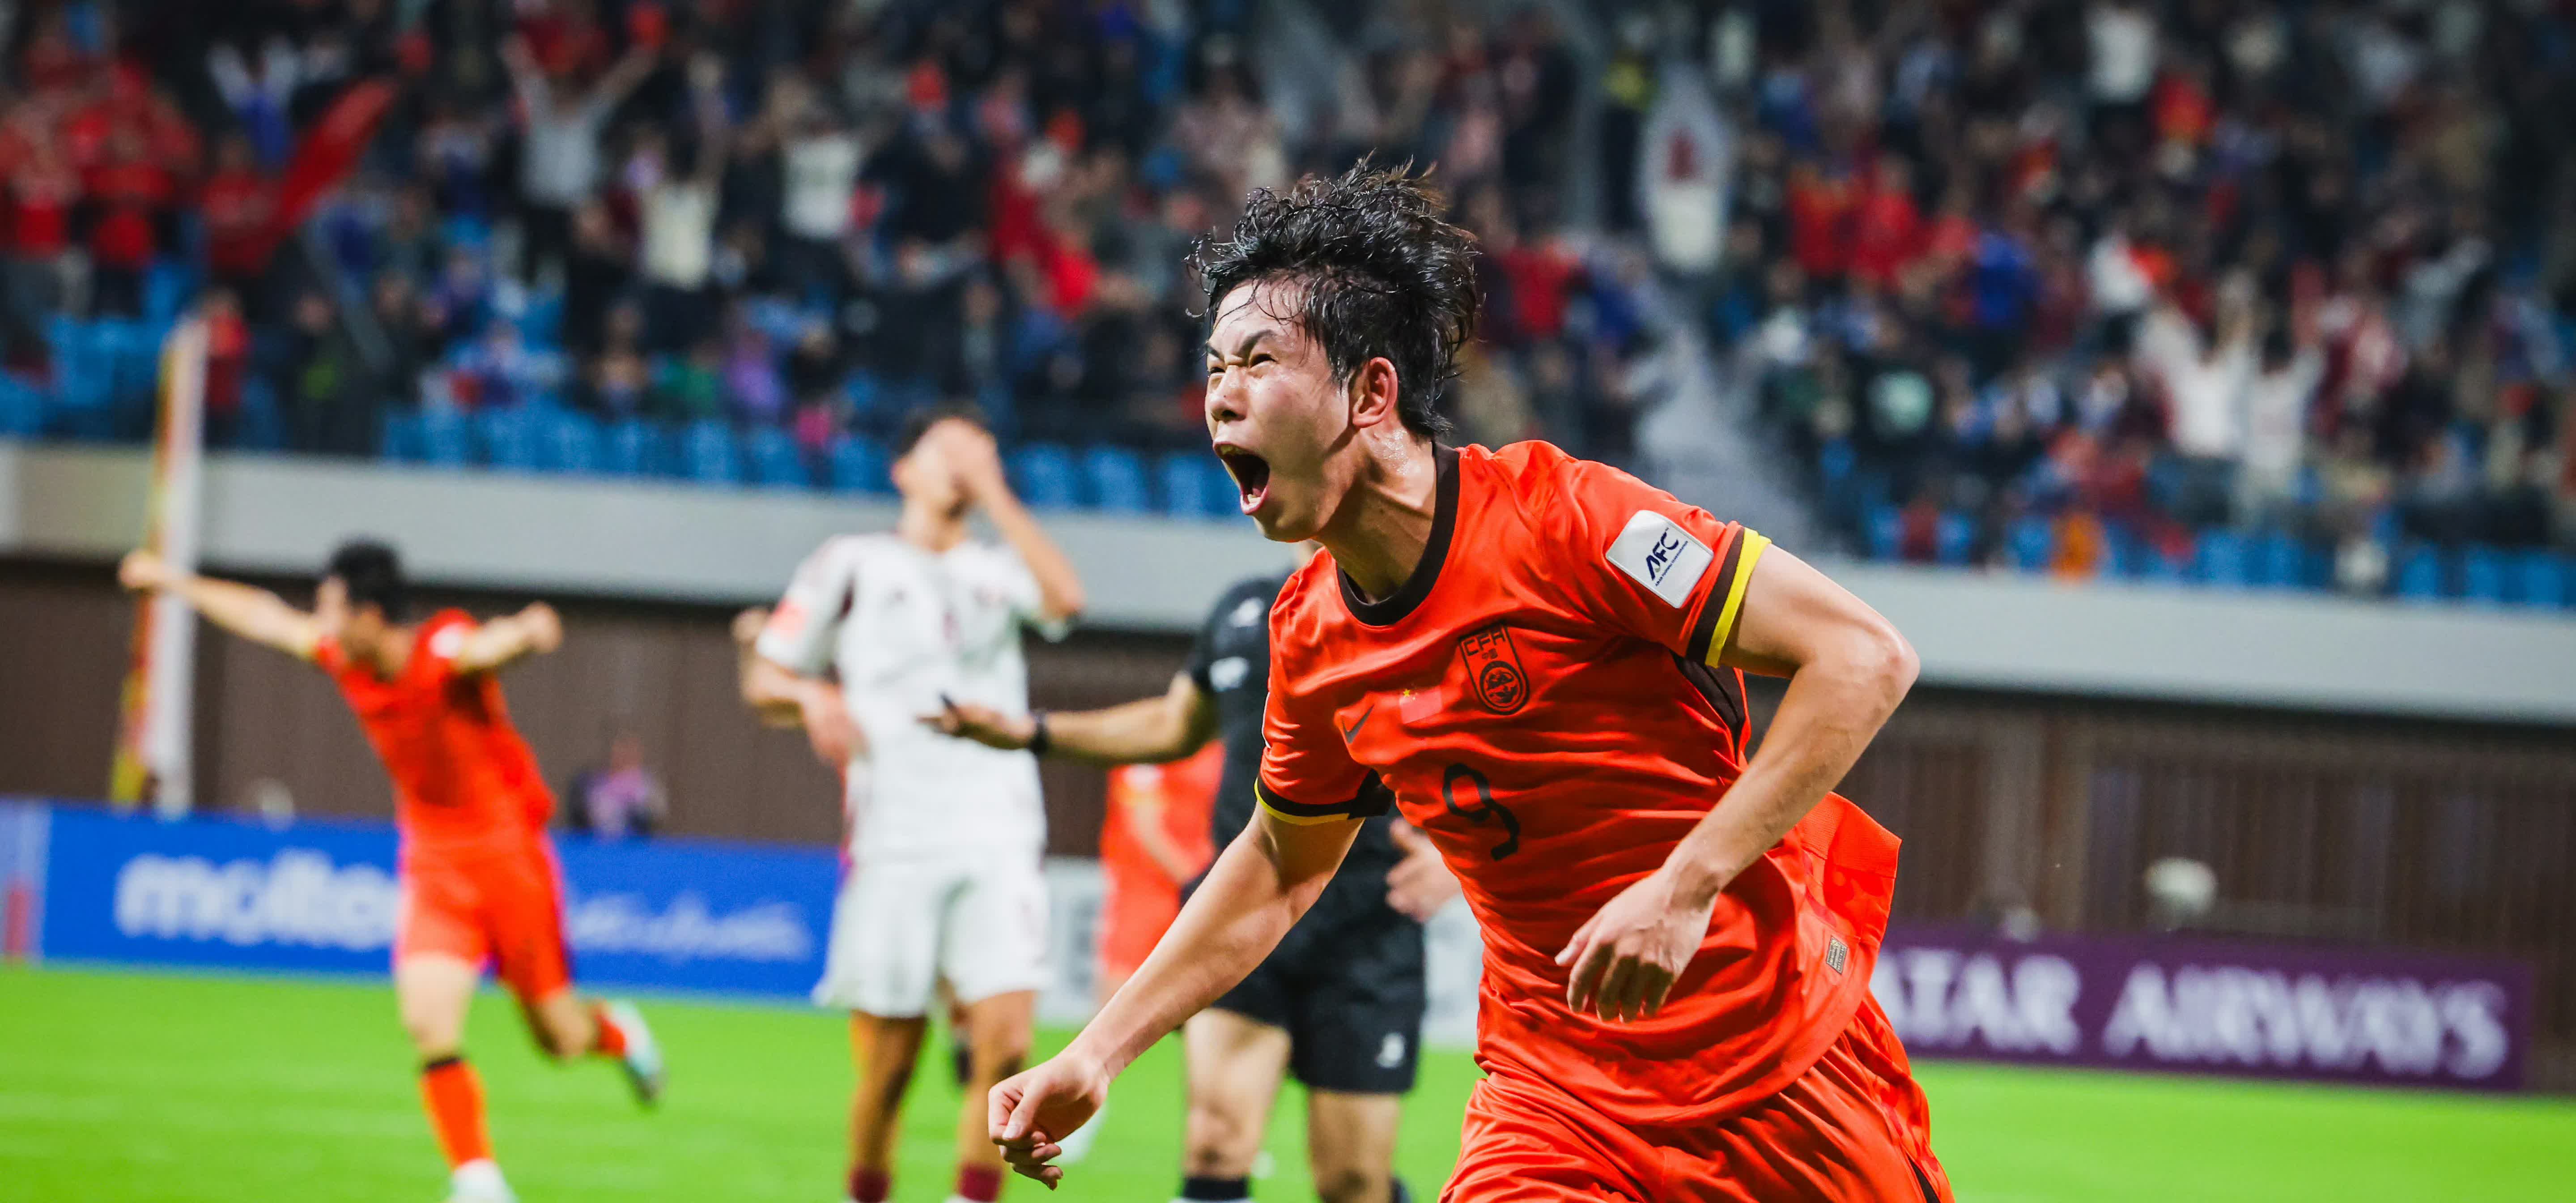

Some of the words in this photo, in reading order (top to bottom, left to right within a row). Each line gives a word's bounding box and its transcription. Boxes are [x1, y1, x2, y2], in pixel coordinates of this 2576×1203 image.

[1646, 531, 1679, 580] AFC
[1464, 628, 1505, 656] CFA
[1442, 763, 1519, 861] 9
[1869, 949, 2081, 1054] ATAR
[2104, 960, 2509, 1078] AIRWAYS
